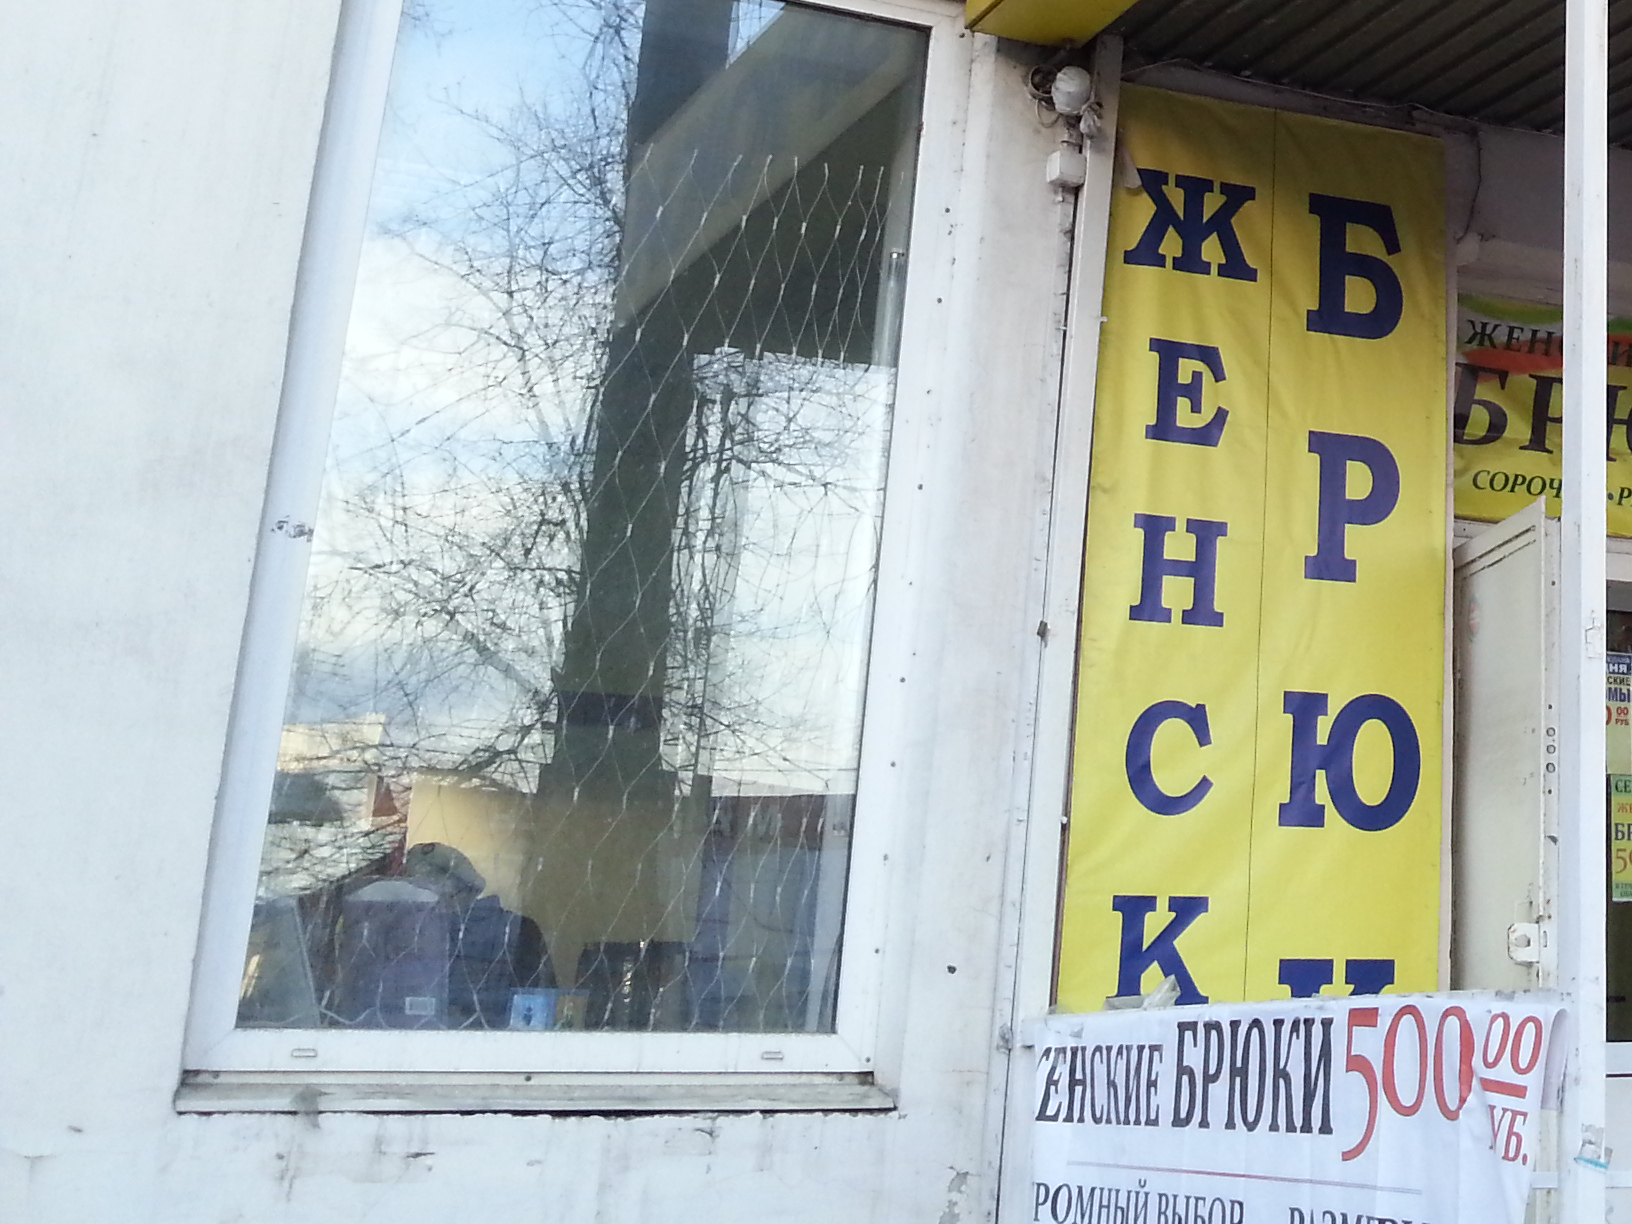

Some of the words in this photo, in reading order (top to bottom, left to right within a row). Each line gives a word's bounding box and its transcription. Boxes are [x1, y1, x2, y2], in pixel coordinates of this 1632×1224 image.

[1472, 469, 1563, 499] СОРОЧ
[1112, 168, 1258, 1007] ЖЕНСК
[1172, 1017, 1335, 1135] БРЮКИ
[1341, 1004, 1476, 1162] 500
[1032, 1179, 1149, 1223] РОМНЫЙ
